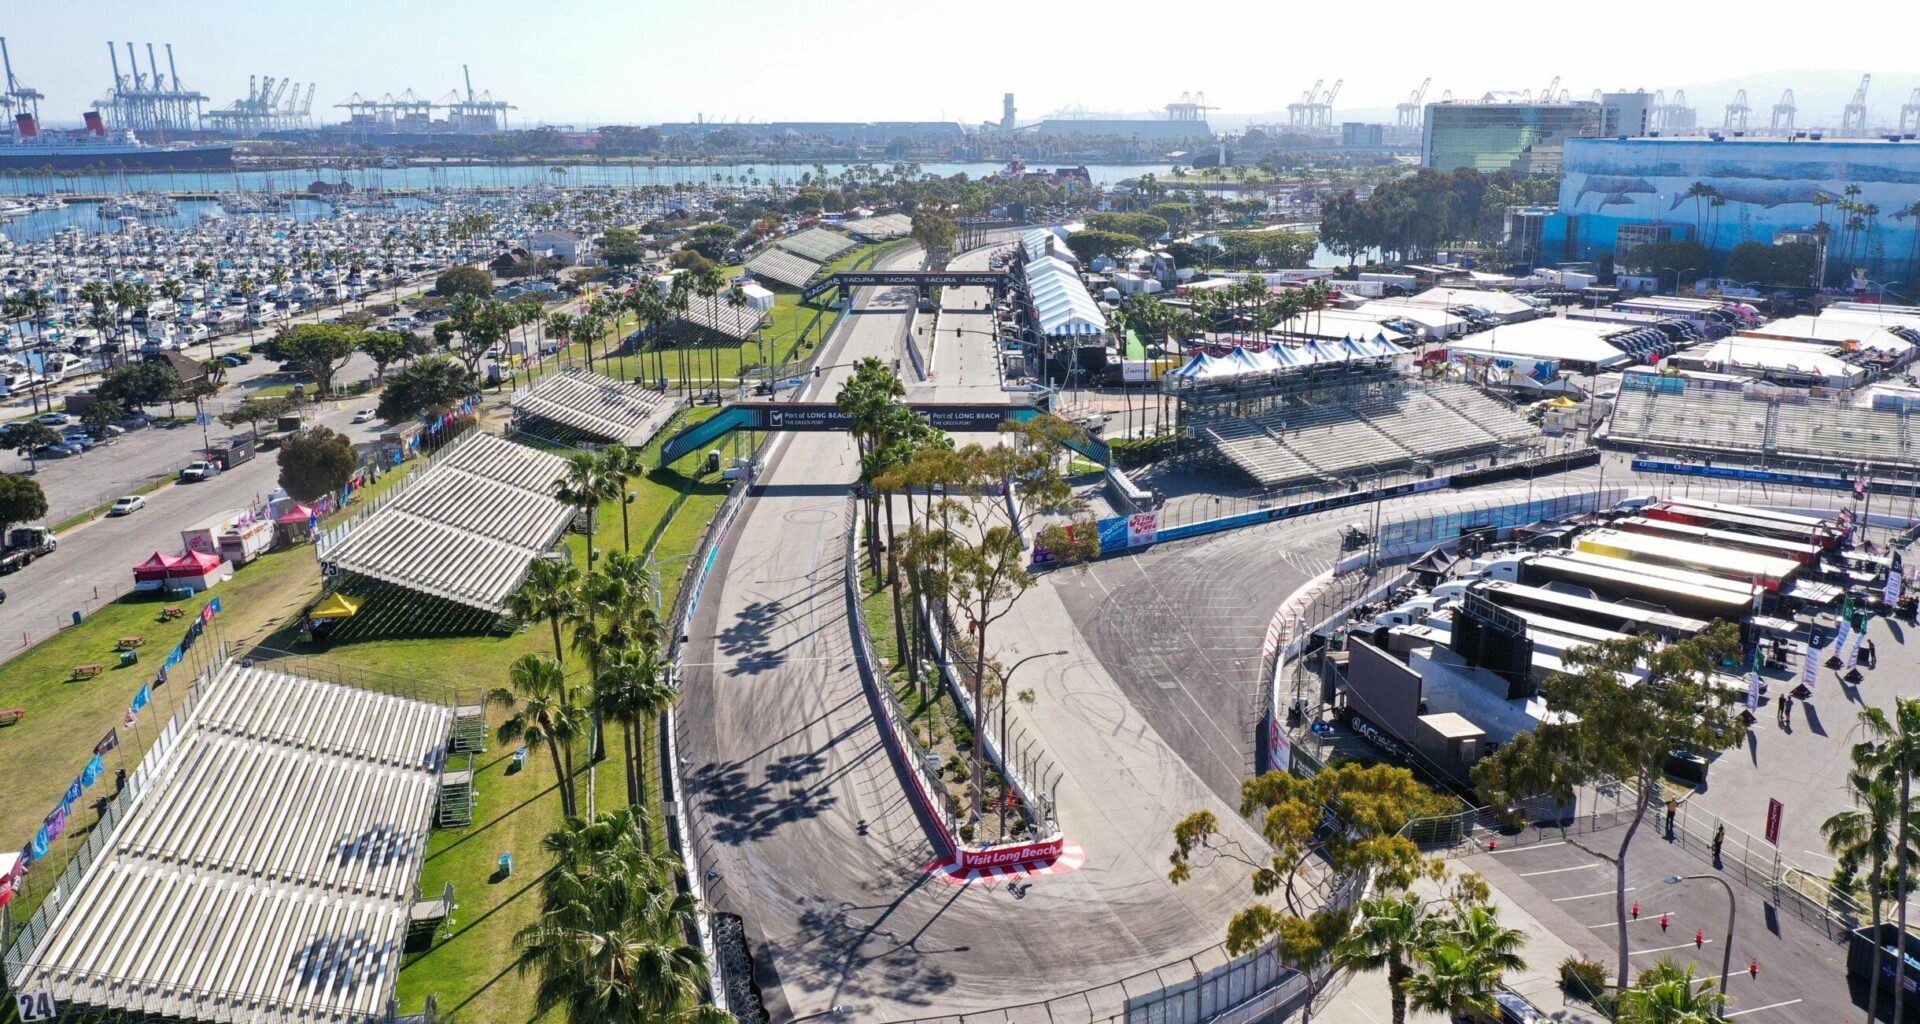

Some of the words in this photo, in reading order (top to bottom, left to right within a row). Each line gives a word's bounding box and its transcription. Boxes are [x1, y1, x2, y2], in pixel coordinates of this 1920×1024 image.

[811, 277, 840, 297] ACURA
[799, 412, 806, 420] of
[946, 412, 954, 420] of
[955, 412, 974, 420] LONG
[976, 412, 1000, 420] BEACH
[320, 561, 338, 577] 25
[1812, 635, 1820, 646] 5
[965, 853, 992, 865] Visit
[992, 852, 1021, 864] Long
[1021, 844, 1056, 859] Beach
[20, 992, 52, 1021] 24
